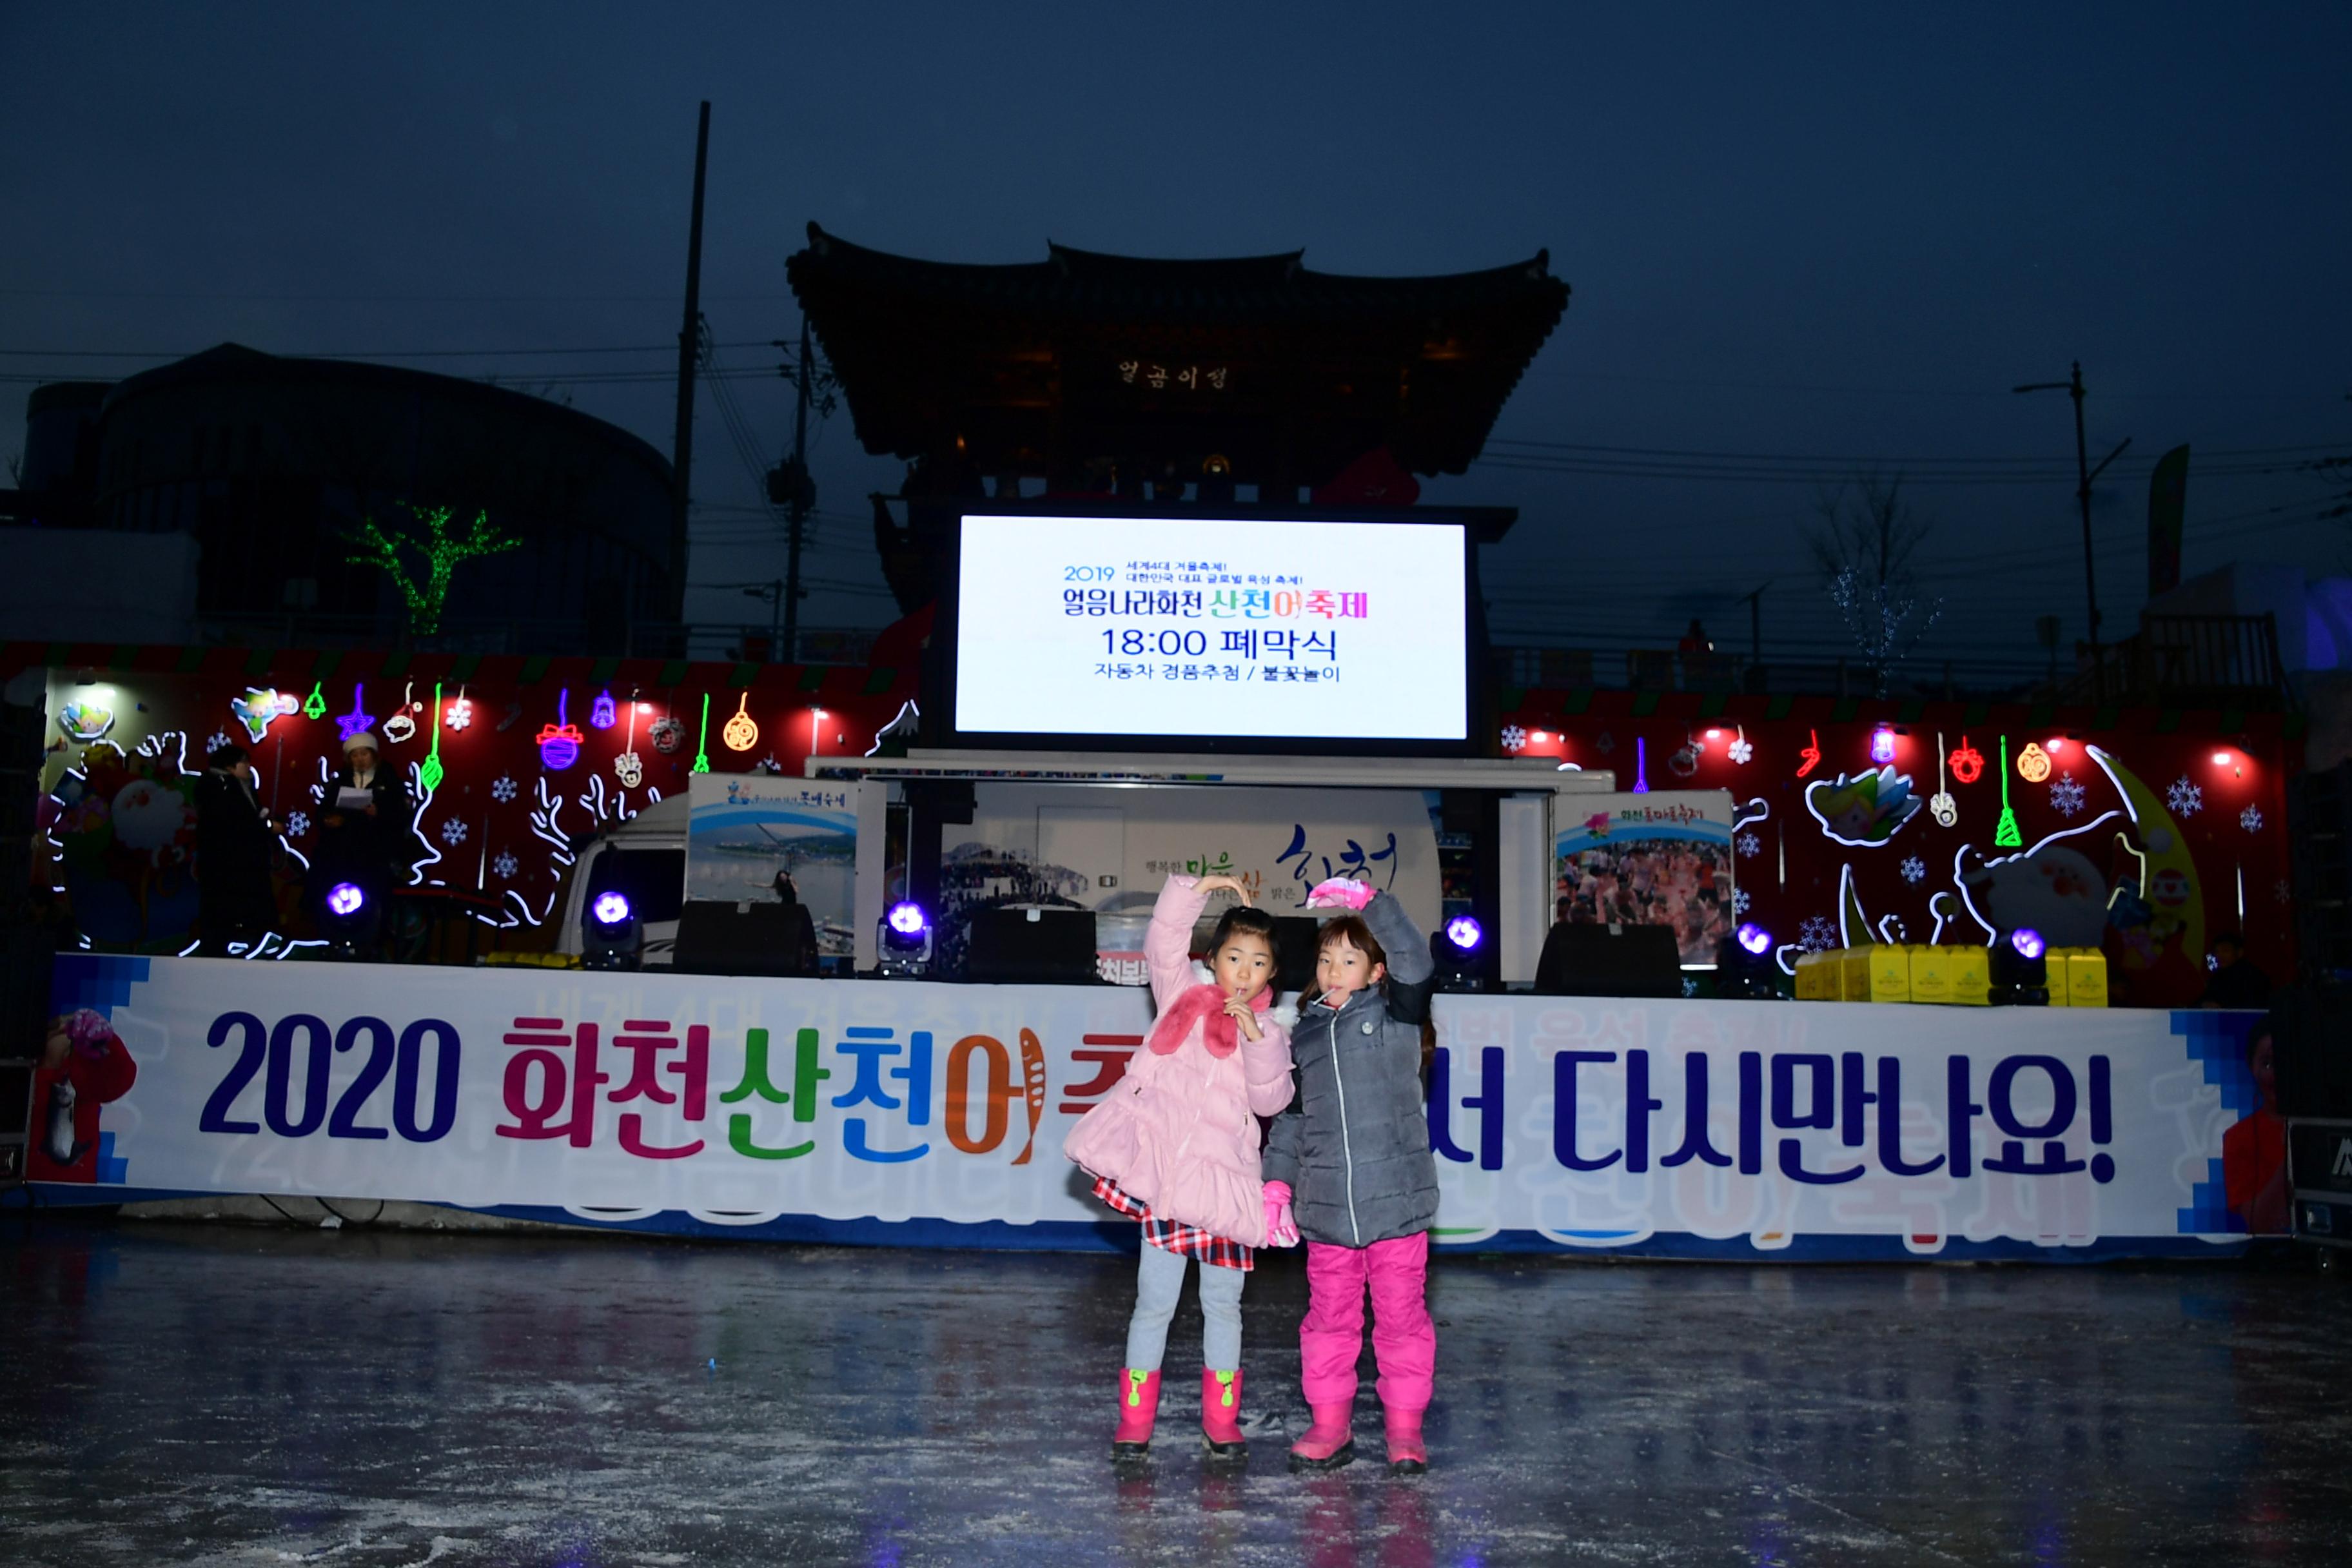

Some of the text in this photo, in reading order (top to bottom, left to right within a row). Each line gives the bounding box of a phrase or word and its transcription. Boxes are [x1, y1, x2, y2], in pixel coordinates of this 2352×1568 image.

[1064, 565, 1115, 582] 2019
[1126, 573, 1173, 583] 대한민국
[1179, 574, 1202, 583] 대표
[1208, 574, 1242, 584] 글로벌
[1208, 589, 1367, 619] 산천어축제
[1102, 629, 1336, 661] 18:00 폐막식
[1095, 663, 1154, 680] 자동차
[1162, 664, 1239, 681] 경품추첨
[1261, 665, 1339, 682] 불꽃놀이
[199, 1011, 461, 1142] 2020
